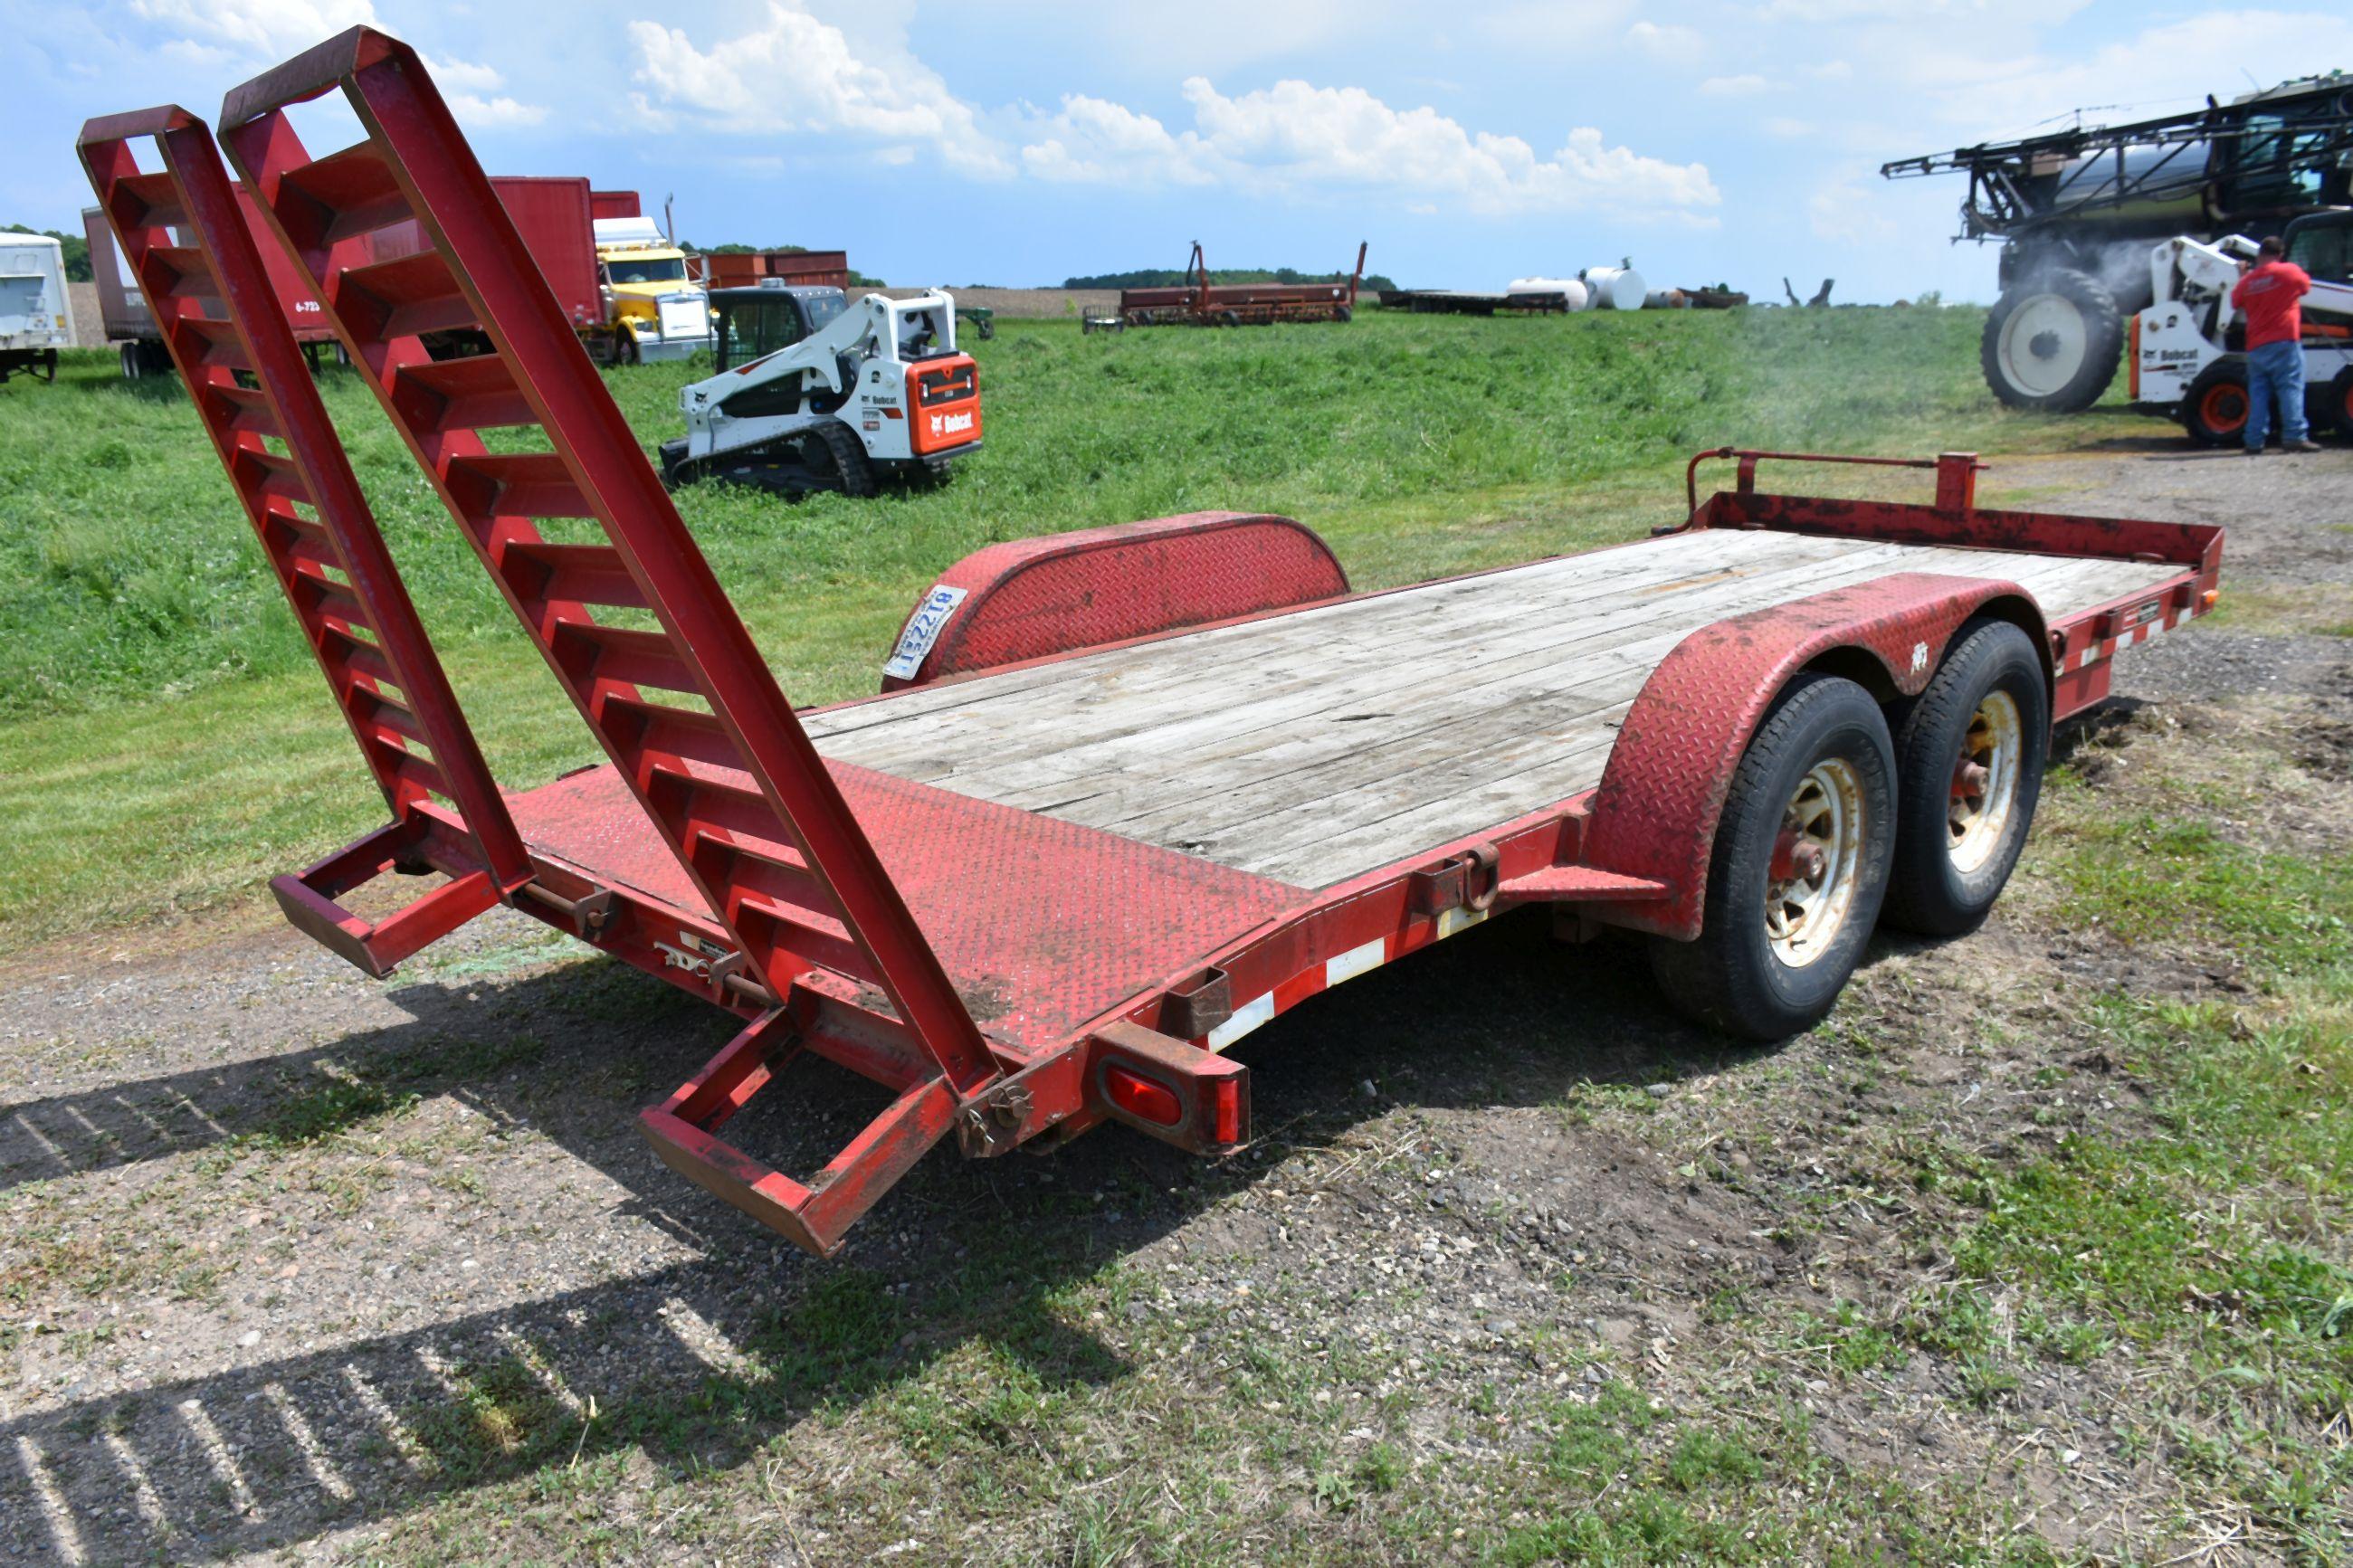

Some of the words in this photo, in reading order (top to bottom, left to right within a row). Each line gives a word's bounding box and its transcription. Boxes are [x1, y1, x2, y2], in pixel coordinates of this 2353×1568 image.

[2160, 348, 2198, 362] Bobcat
[872, 395, 897, 405] Bobcat
[944, 412, 972, 433] Bobcat
